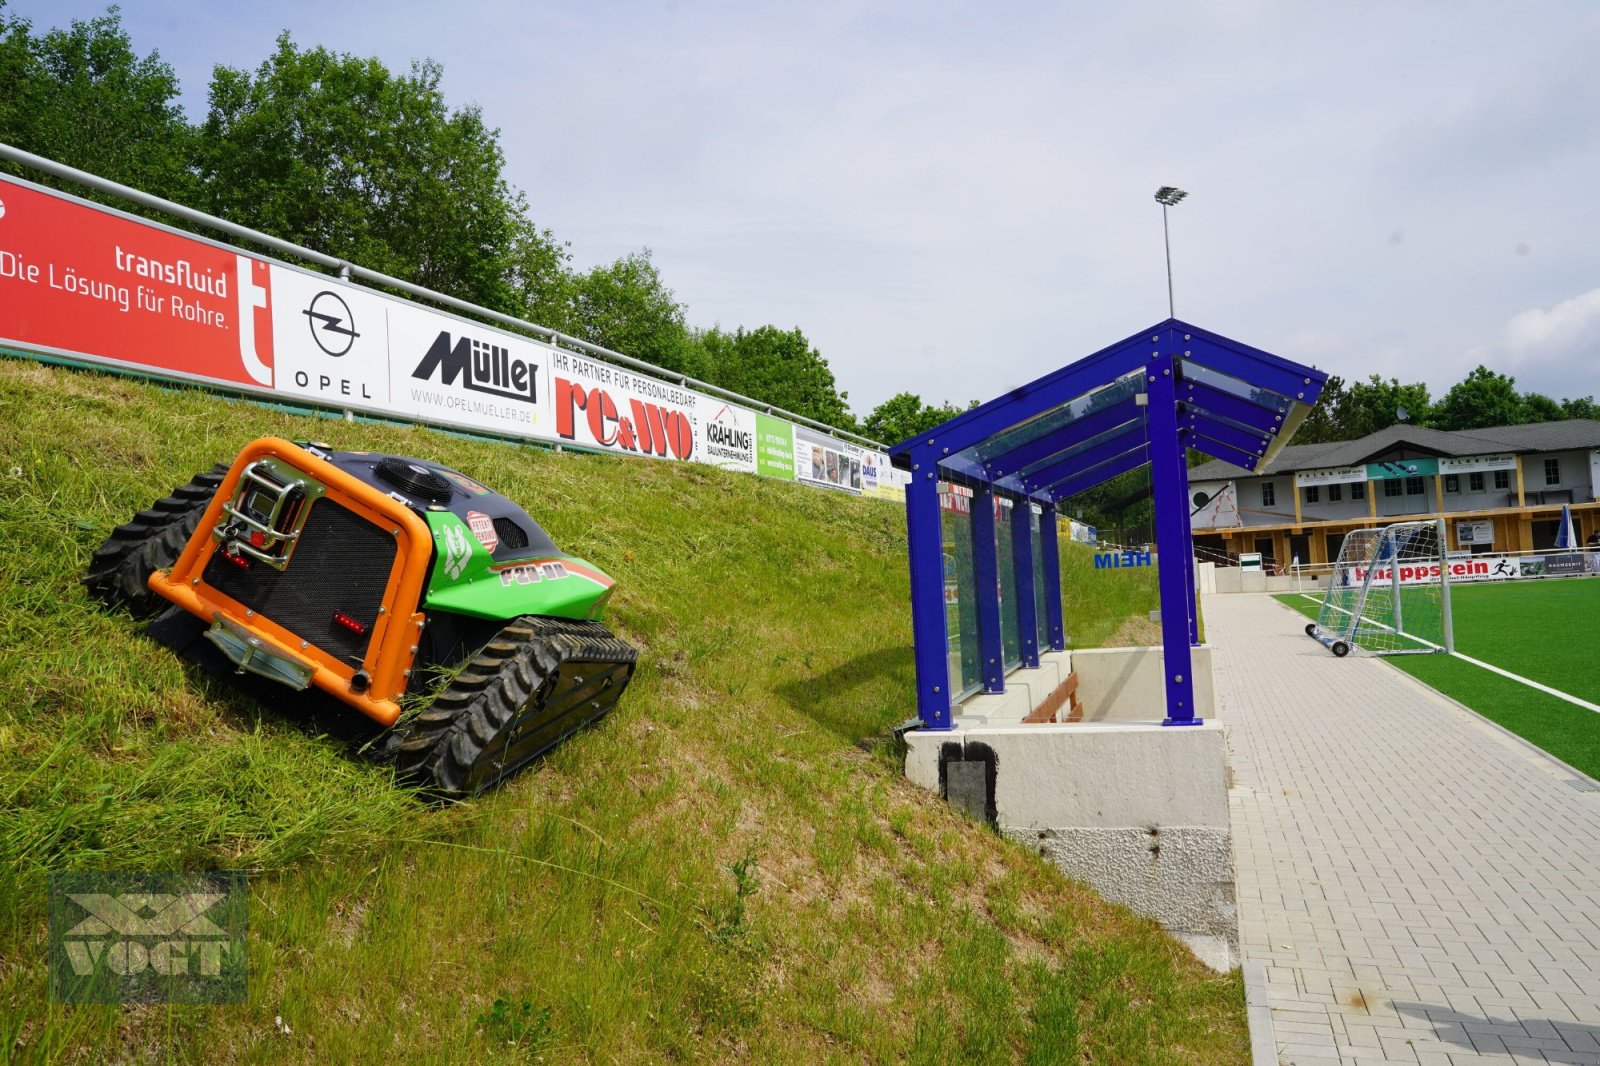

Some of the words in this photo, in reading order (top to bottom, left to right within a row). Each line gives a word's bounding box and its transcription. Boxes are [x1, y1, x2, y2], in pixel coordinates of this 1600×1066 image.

[0, 250, 40, 284] Die
[49, 263, 129, 312] Lösung
[137, 285, 165, 313] für
[171, 295, 229, 330] Rohre.
[115, 245, 227, 298] transfluid
[295, 370, 371, 399] OPEL
[411, 330, 539, 405] Müller
[553, 352, 569, 372] IHR
[573, 358, 611, 385] PARTNER
[633, 378, 696, 409] PERSONALBEDARF
[411, 388, 531, 424] WWW.OPELMUELLER.DE
[707, 420, 749, 450] KRÄHLING
[472, 519, 490, 531] PATENT
